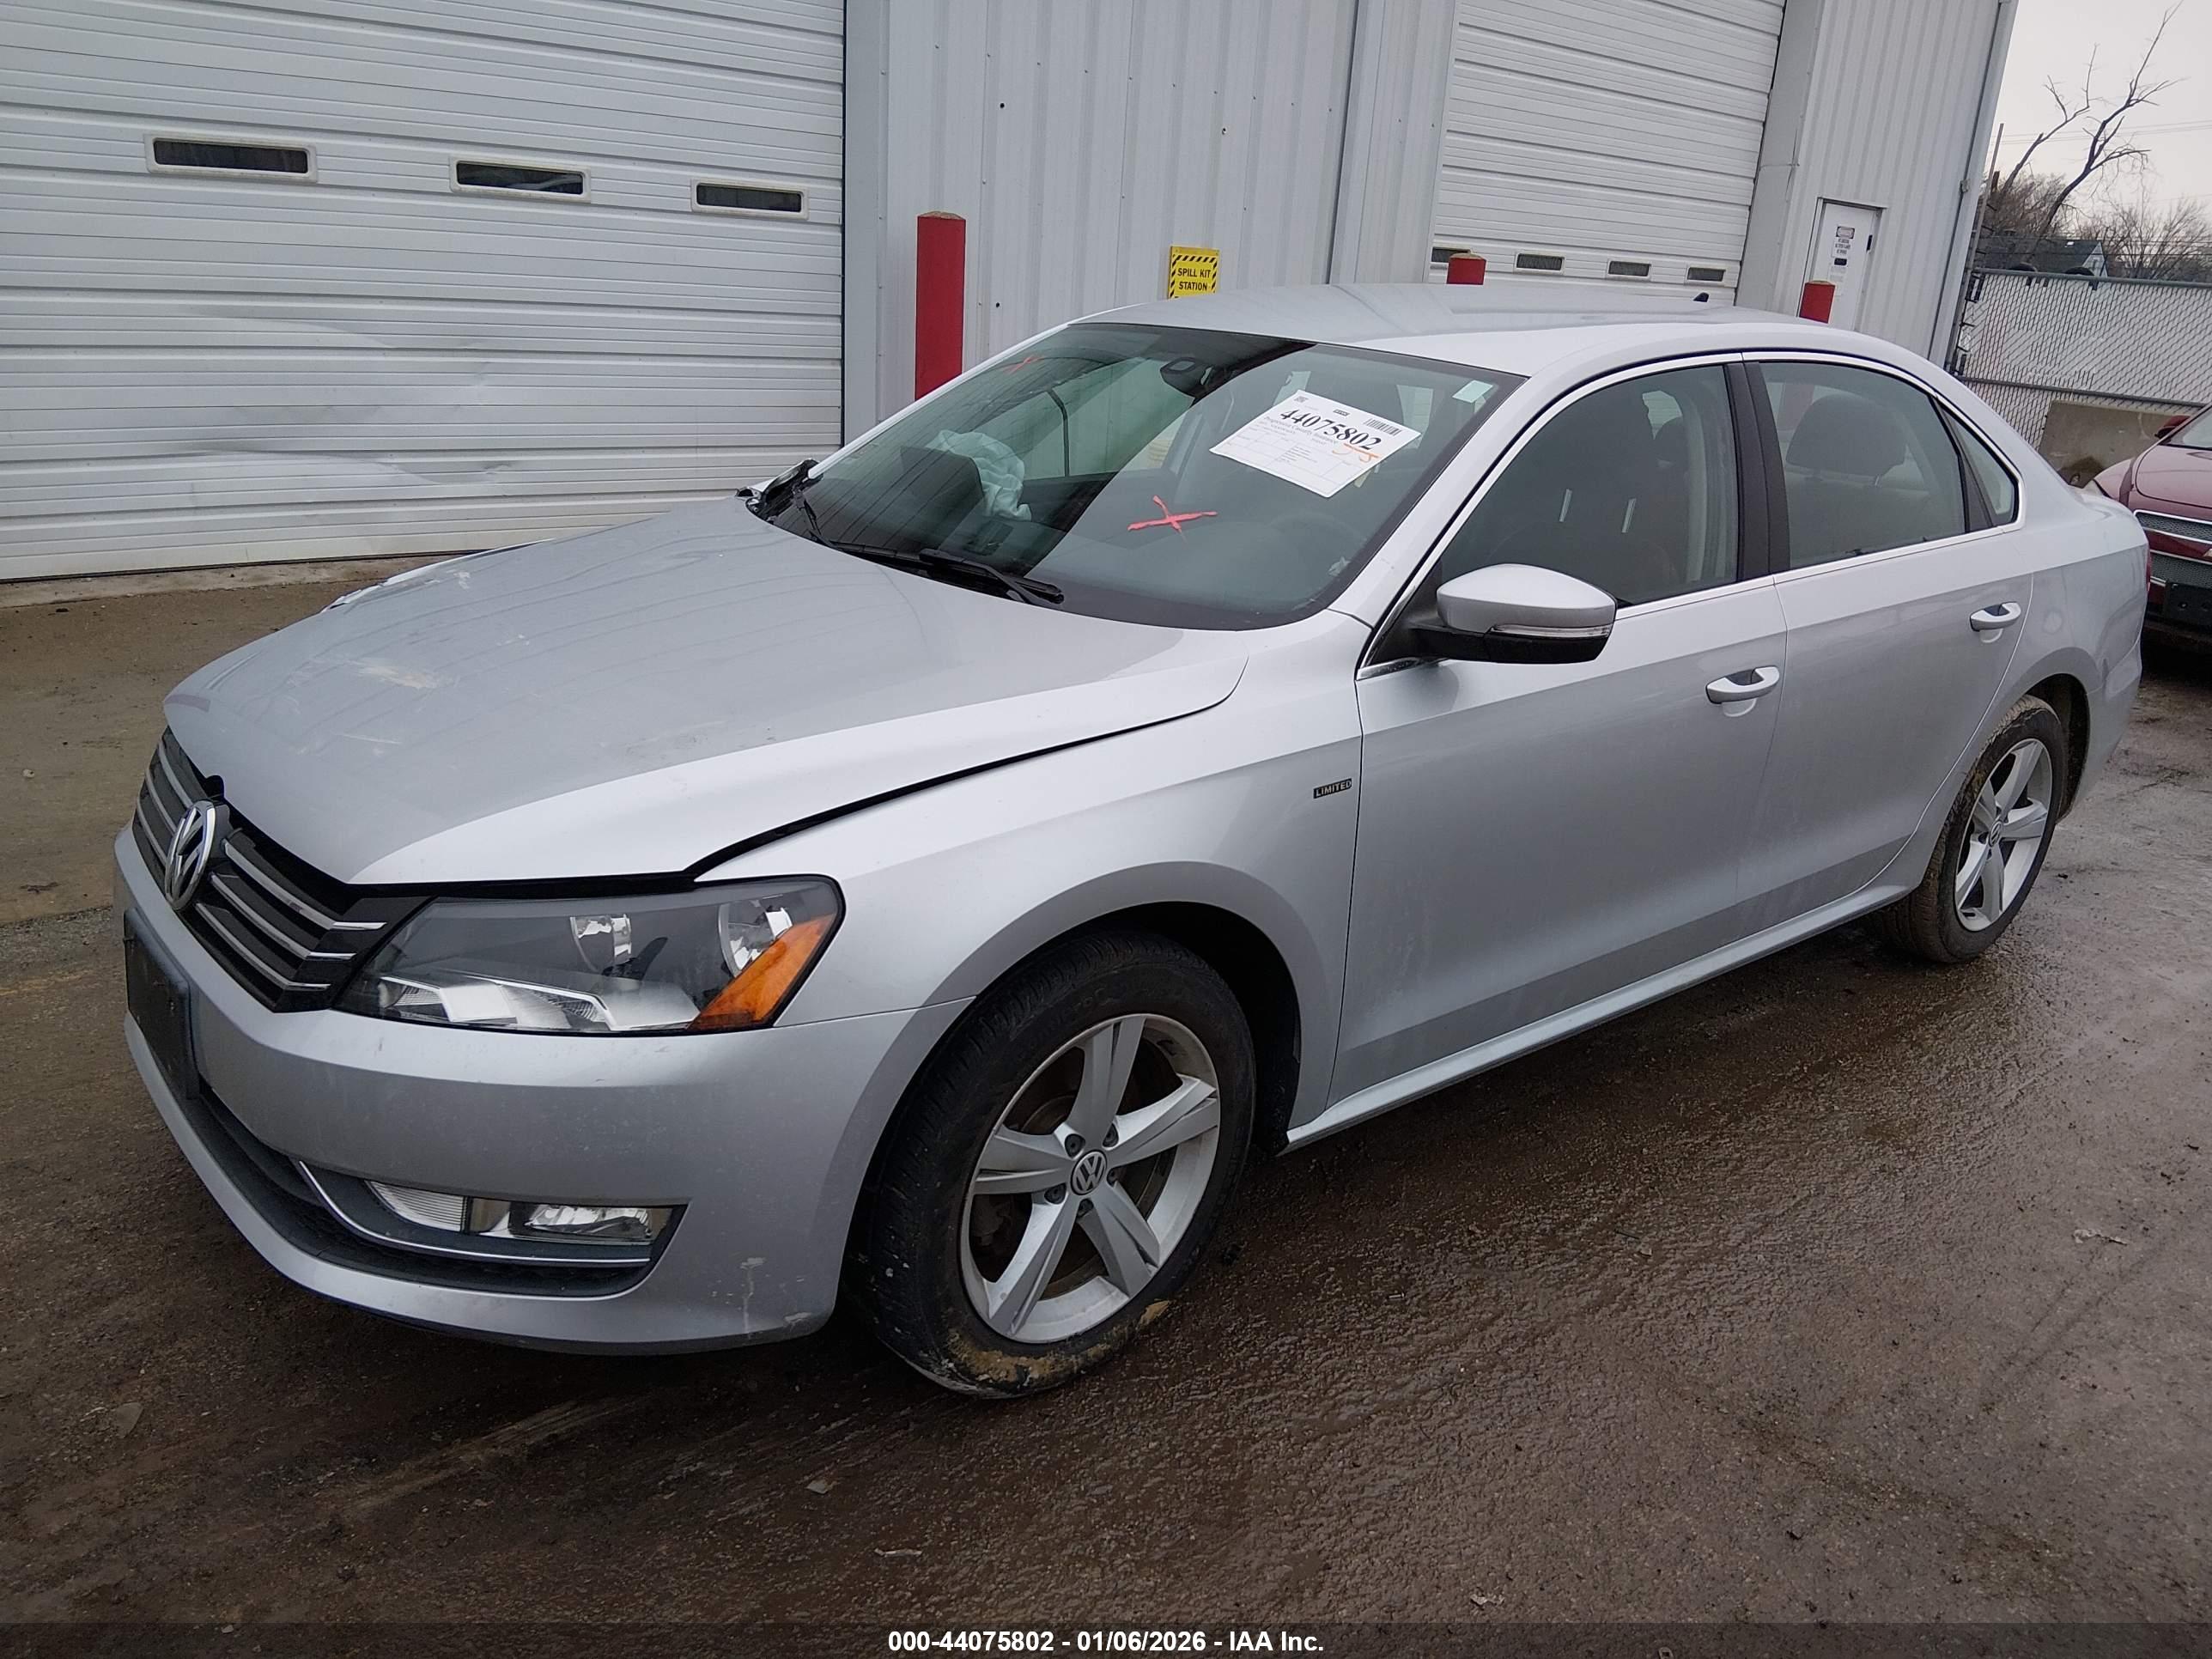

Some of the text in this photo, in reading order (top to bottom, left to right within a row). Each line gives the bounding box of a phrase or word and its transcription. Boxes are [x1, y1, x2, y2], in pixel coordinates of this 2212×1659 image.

[1177, 267, 1211, 278] SPILL KIT
[1178, 281, 1207, 291] STATION
[1279, 409, 1382, 451] 44075802
[1316, 780, 1352, 797] LIMITED
